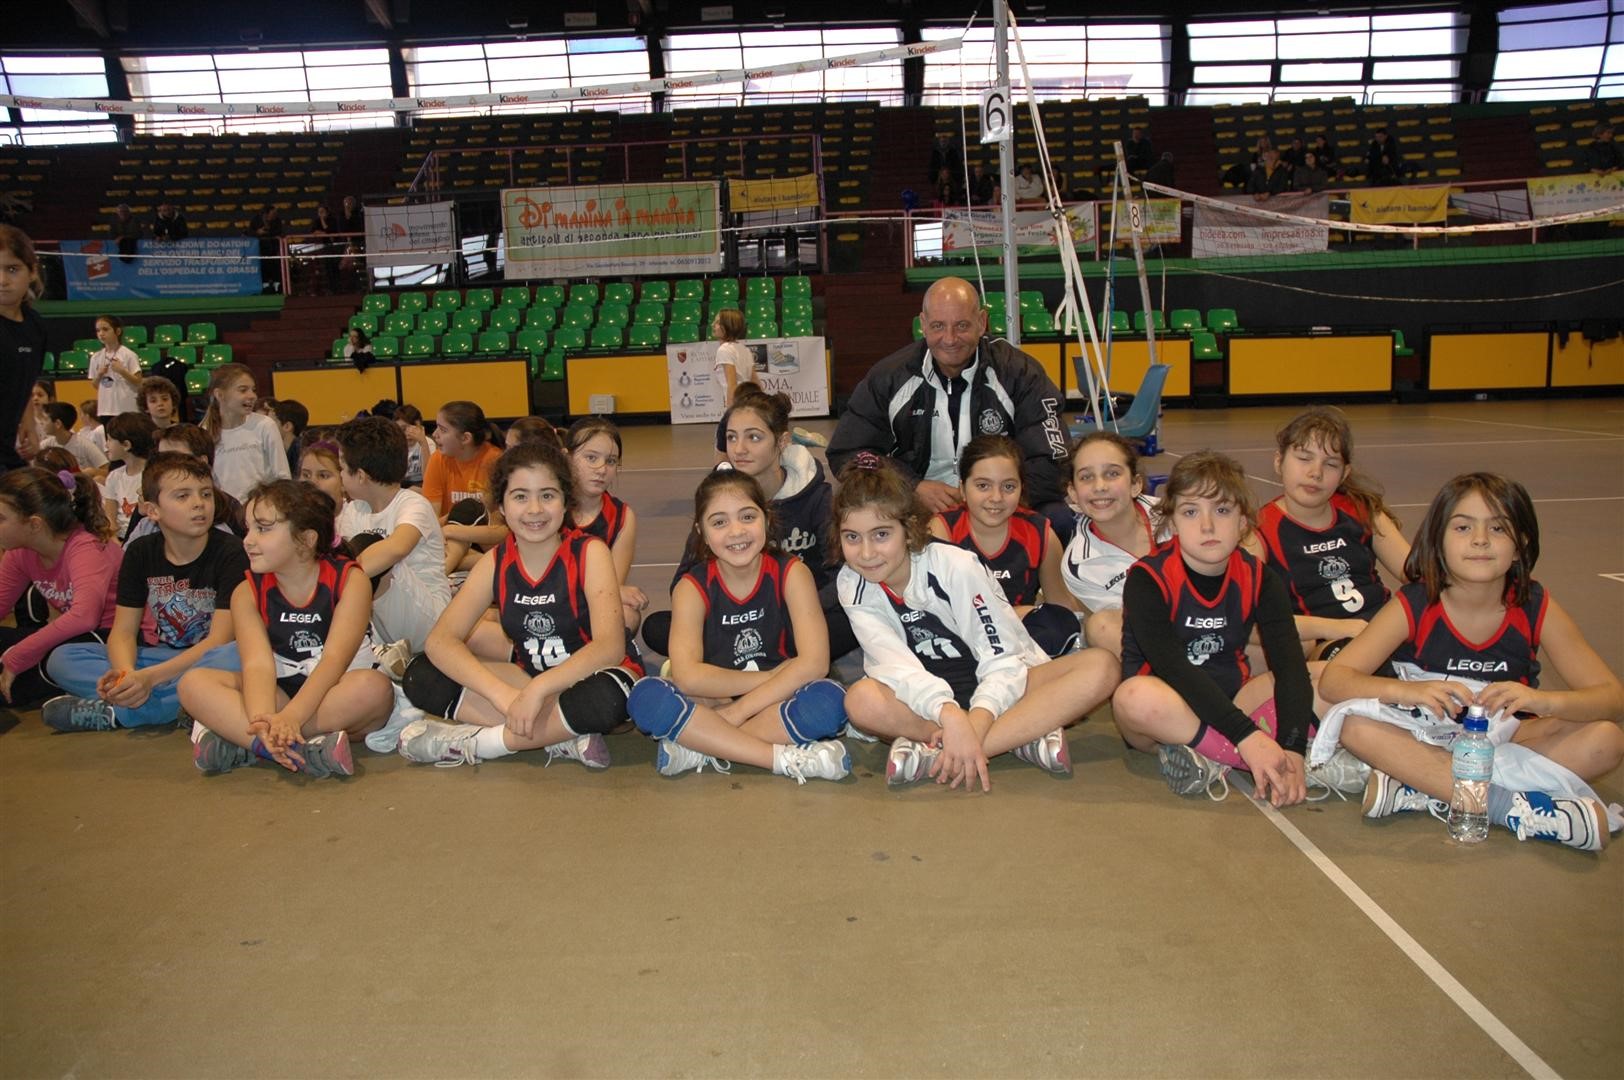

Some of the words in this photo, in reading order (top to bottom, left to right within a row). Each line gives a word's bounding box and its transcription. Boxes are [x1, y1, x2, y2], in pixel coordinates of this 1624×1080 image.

[908, 44, 936, 55] Kinder
[827, 57, 857, 69] Kinder
[744, 69, 774, 80] Kinder
[663, 80, 693, 89] Kinder
[580, 87, 609, 97] Kinder
[417, 98, 446, 109] Kinder
[500, 94, 529, 104] Kinder
[95, 102, 124, 112] Kinder
[177, 104, 206, 114] Kinder
[256, 104, 285, 114] Kinder
[337, 102, 367, 111] Kinder
[986, 93, 1006, 135] 6
[1131, 206, 1140, 228] 8
[138, 267, 207, 276] DELL'OSPEDALE
[227, 266, 258, 274] GRASSI
[760, 378, 793, 390] OMA,
[791, 391, 819, 404] NDIALE
[1303, 537, 1347, 554] LEGEA
[1104, 571, 1127, 591] LEGE
[514, 593, 556, 605] LEGEA
[280, 612, 322, 624] LEGEA
[976, 606, 1005, 656] LEGEA
[914, 637, 963, 660] 11
[1447, 658, 1508, 673] LEGEA
